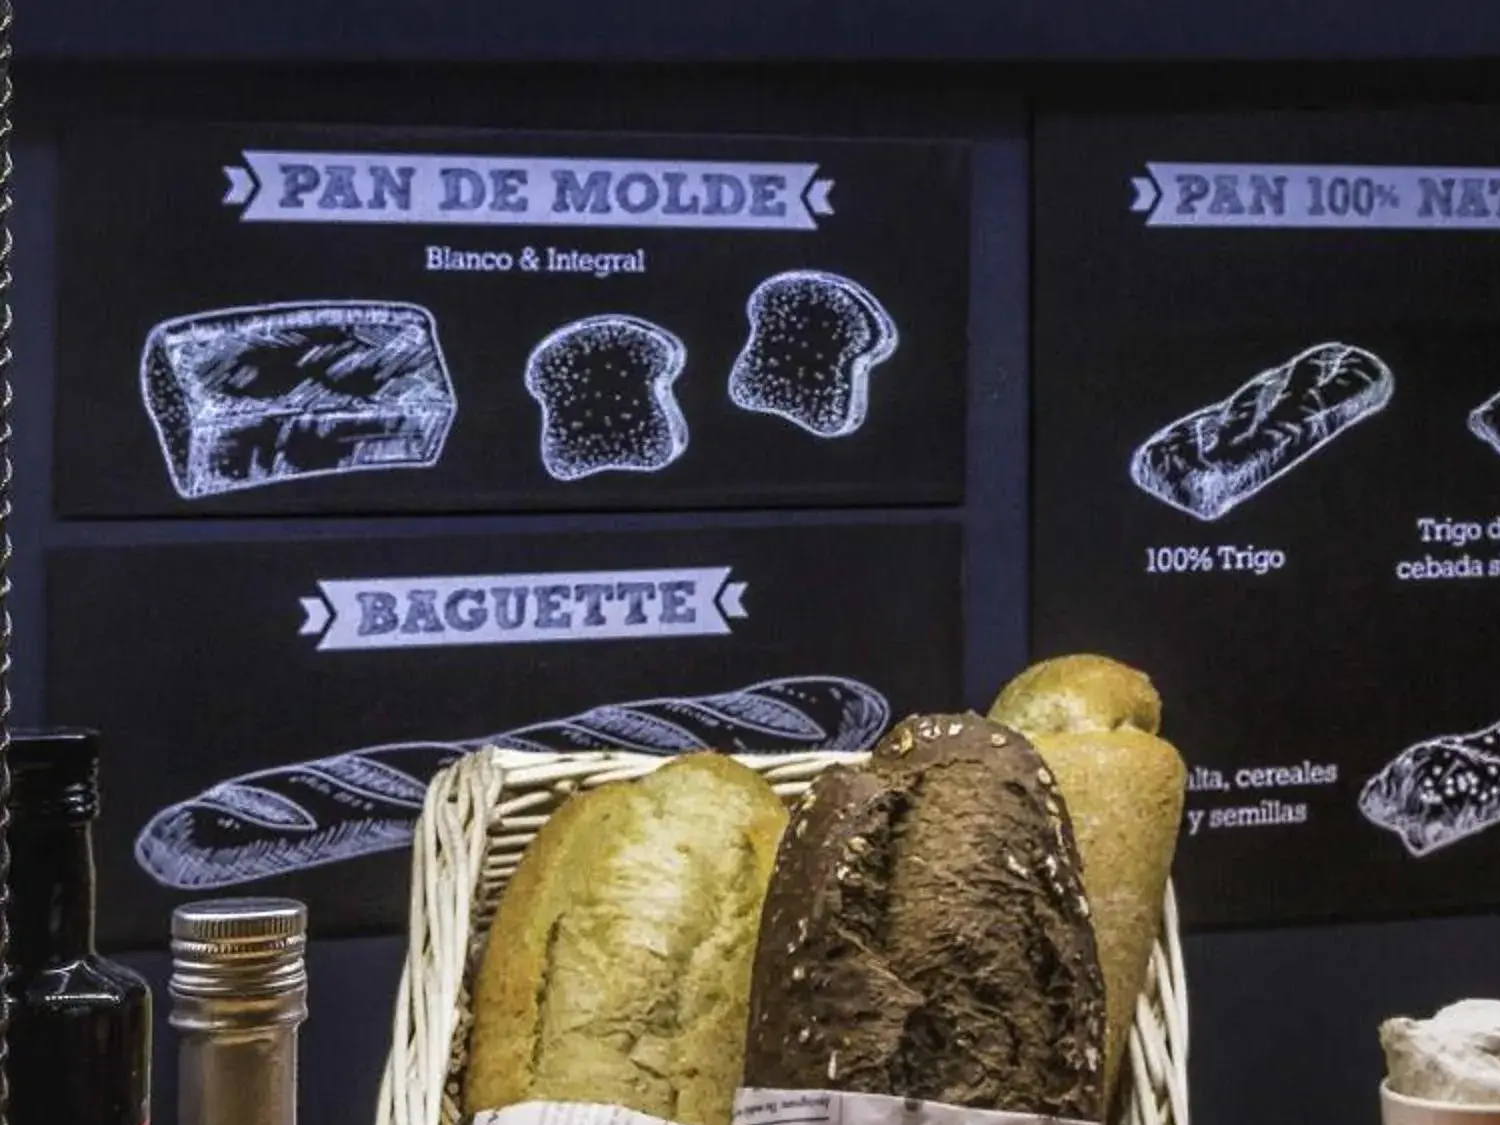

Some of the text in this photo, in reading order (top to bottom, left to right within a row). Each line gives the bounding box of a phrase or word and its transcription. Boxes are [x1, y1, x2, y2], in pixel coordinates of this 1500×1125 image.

[278, 164, 786, 217] PAN DE MOLDE
[1174, 173, 1289, 216] PAN
[1306, 176, 1400, 217] 100%
[425, 245, 646, 278] Blanco & Integral
[1416, 517, 1483, 547] Trigo
[1145, 545, 1286, 576] 100% Trigo
[1395, 553, 1484, 580] cebada
[355, 580, 698, 637] BAGUETTE
[1234, 760, 1339, 788] cereales
[1187, 799, 1308, 836] y semillas
